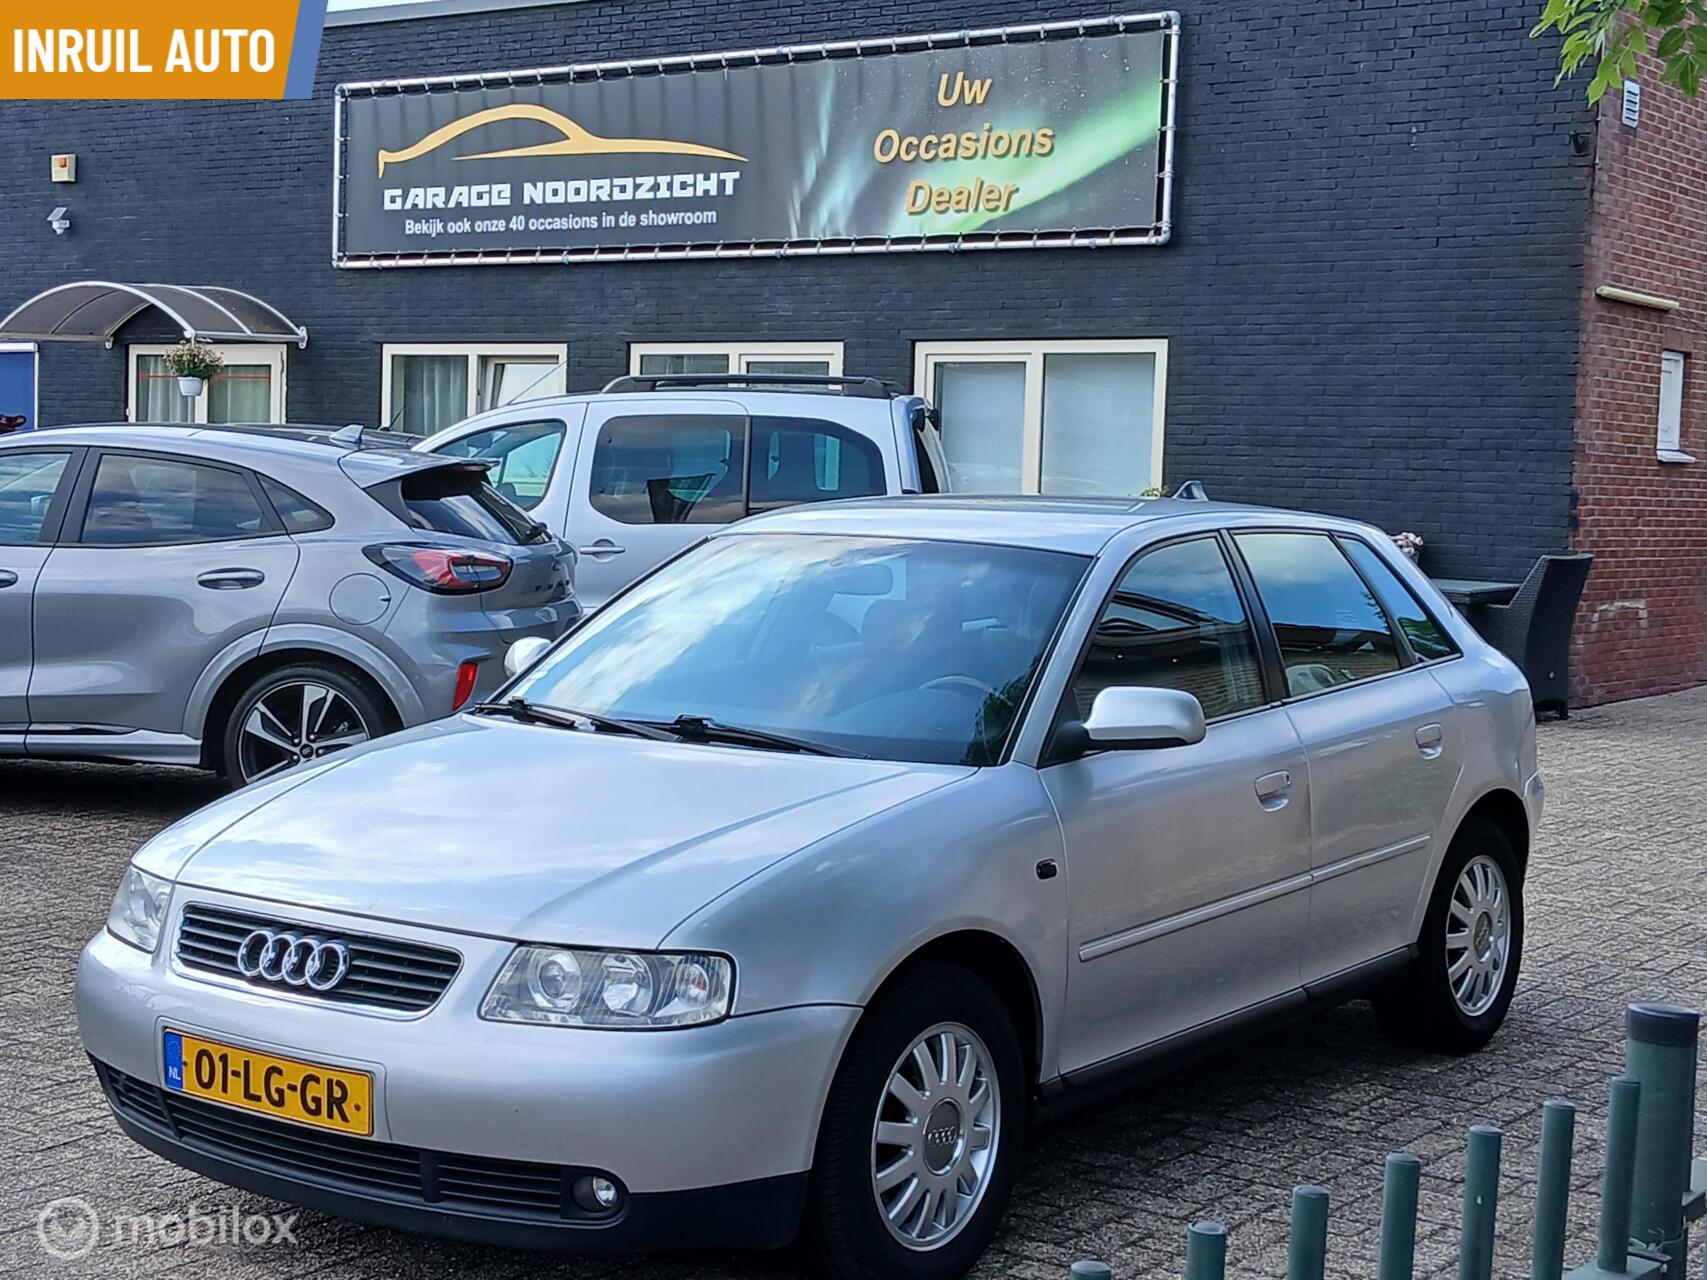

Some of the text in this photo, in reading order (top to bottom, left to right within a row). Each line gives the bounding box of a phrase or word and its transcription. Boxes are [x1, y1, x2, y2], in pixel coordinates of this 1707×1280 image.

[937, 71, 993, 107] Uw
[873, 122, 1054, 163] Occasions
[383, 171, 741, 211] GARAGE NOORDZICHT
[905, 176, 1019, 214] Dealer
[404, 209, 718, 238] Bekijk ook onze 40 occasions in de showroom
[168, 1065, 181, 1081] NL
[194, 1048, 350, 1123] 01-LG-GR
